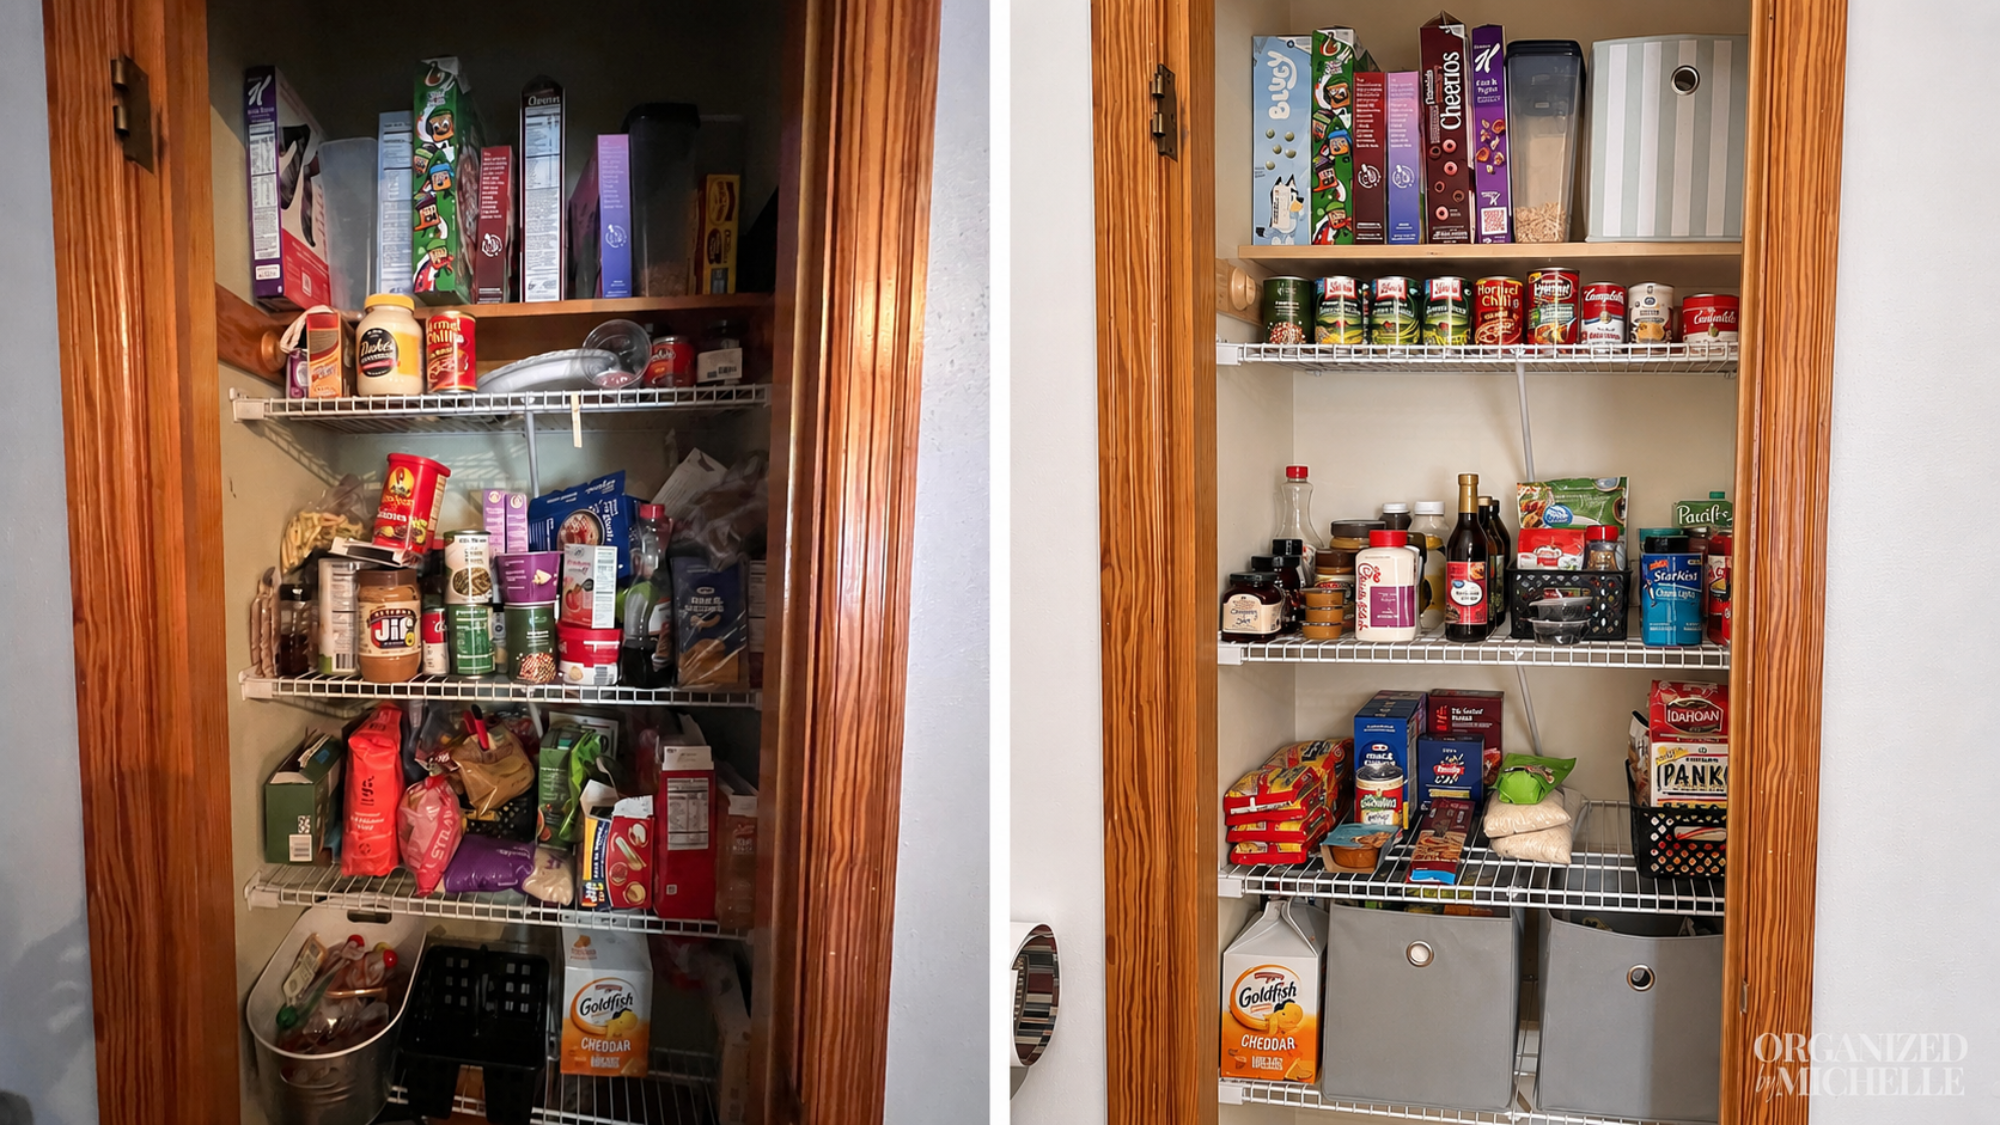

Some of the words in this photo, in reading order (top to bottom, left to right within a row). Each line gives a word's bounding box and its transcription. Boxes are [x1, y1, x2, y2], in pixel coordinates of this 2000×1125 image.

[374, 616, 414, 642] Jif
[1667, 708, 1720, 724] IDAHOAN
[580, 991, 634, 1017] Goldfish
[1239, 980, 1298, 1009] Goldfish
[580, 1036, 631, 1053] CHEDDAR
[1241, 1033, 1296, 1051] CHEDDAR
